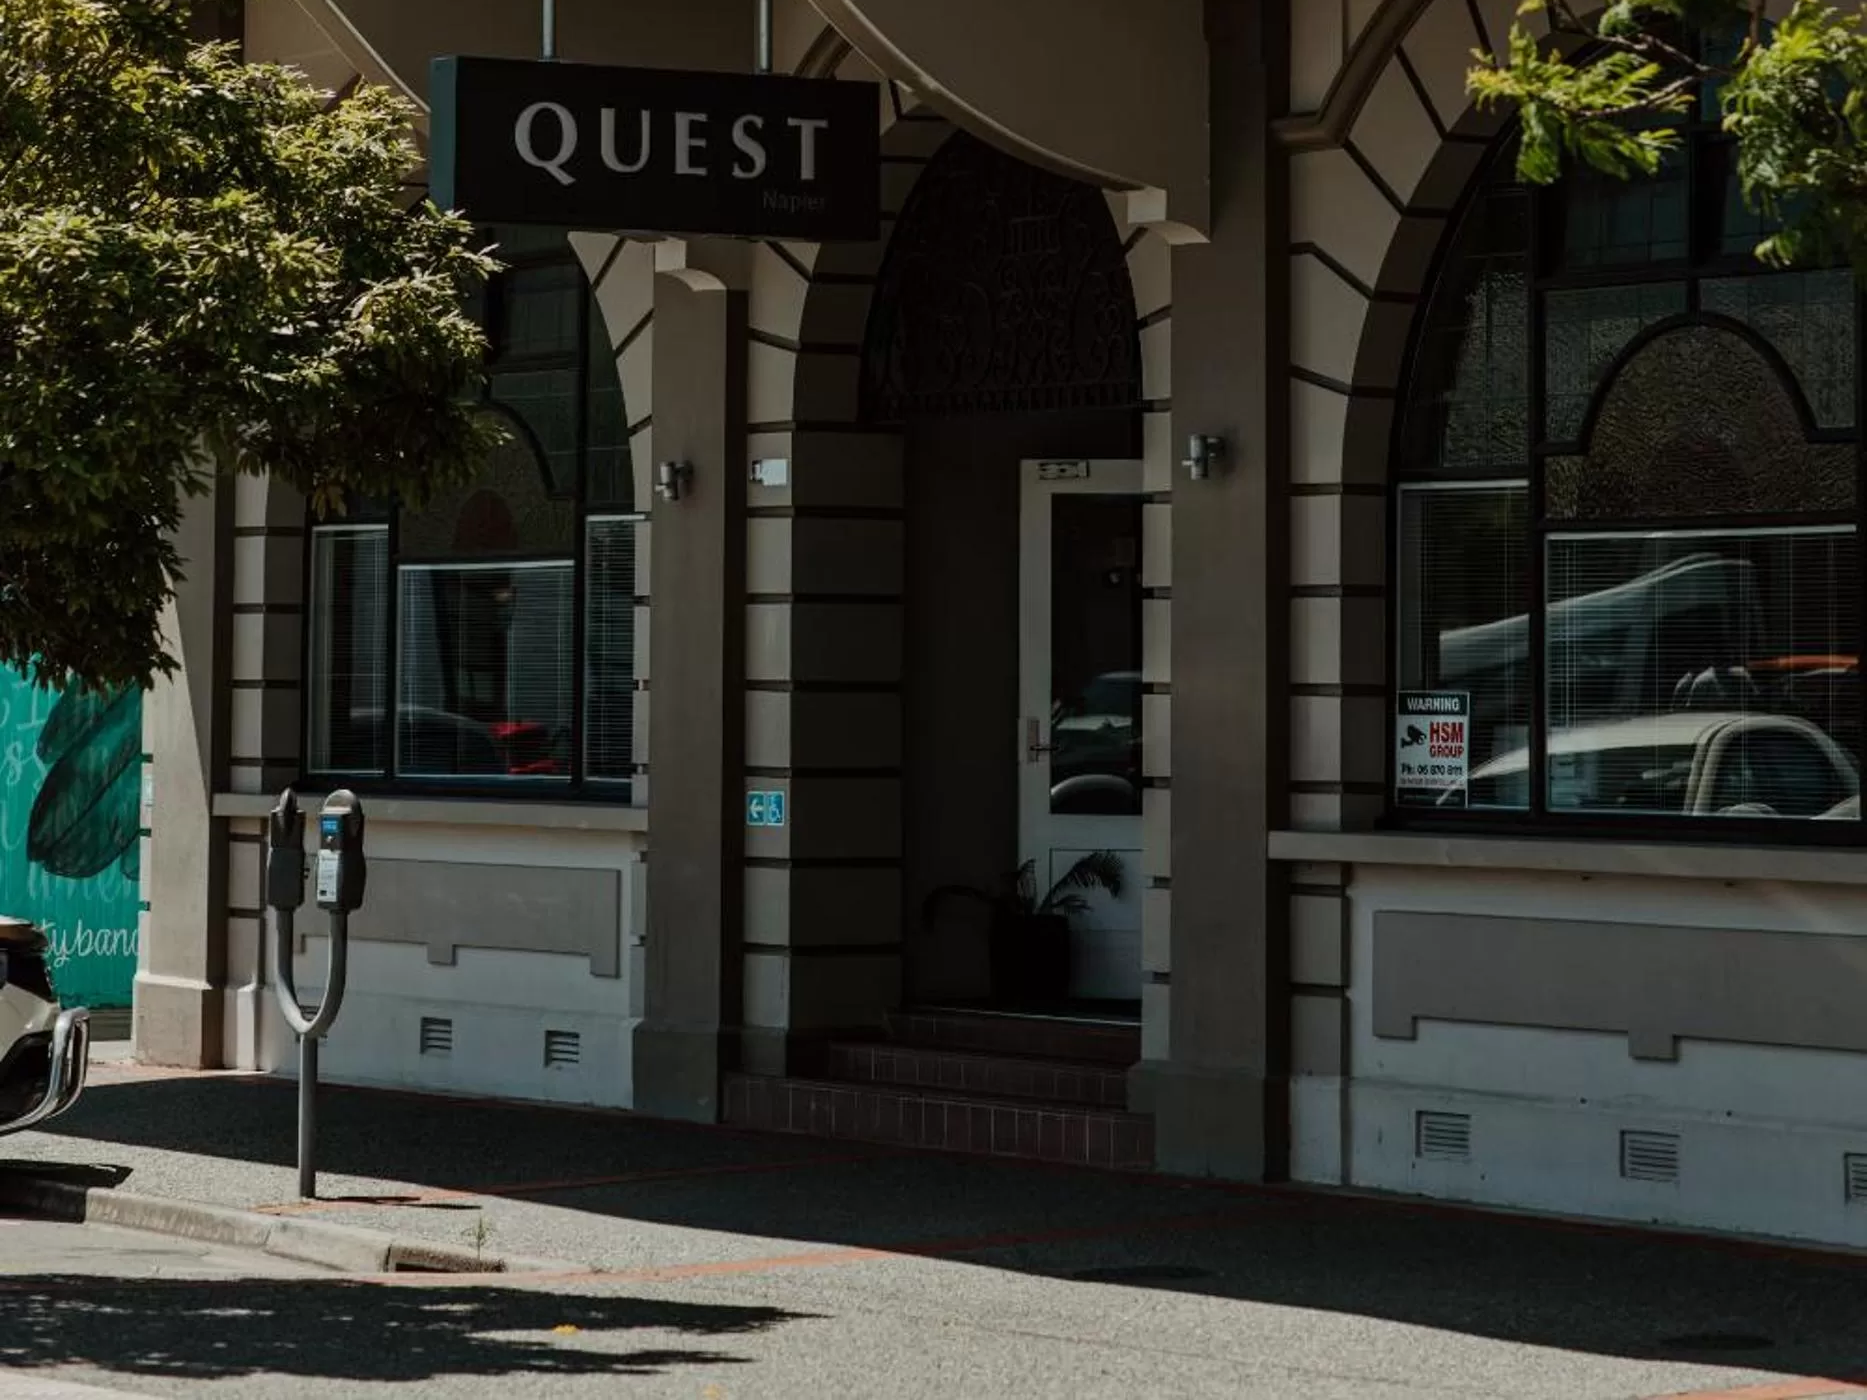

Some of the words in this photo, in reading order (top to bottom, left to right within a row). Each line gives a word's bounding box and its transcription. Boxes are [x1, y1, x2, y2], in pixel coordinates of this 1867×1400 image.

[514, 100, 829, 185] QUEST
[762, 189, 825, 213] Napier
[1407, 697, 1460, 711] WARNING
[1429, 721, 1464, 743] HSM
[1429, 745, 1464, 758] GROUP
